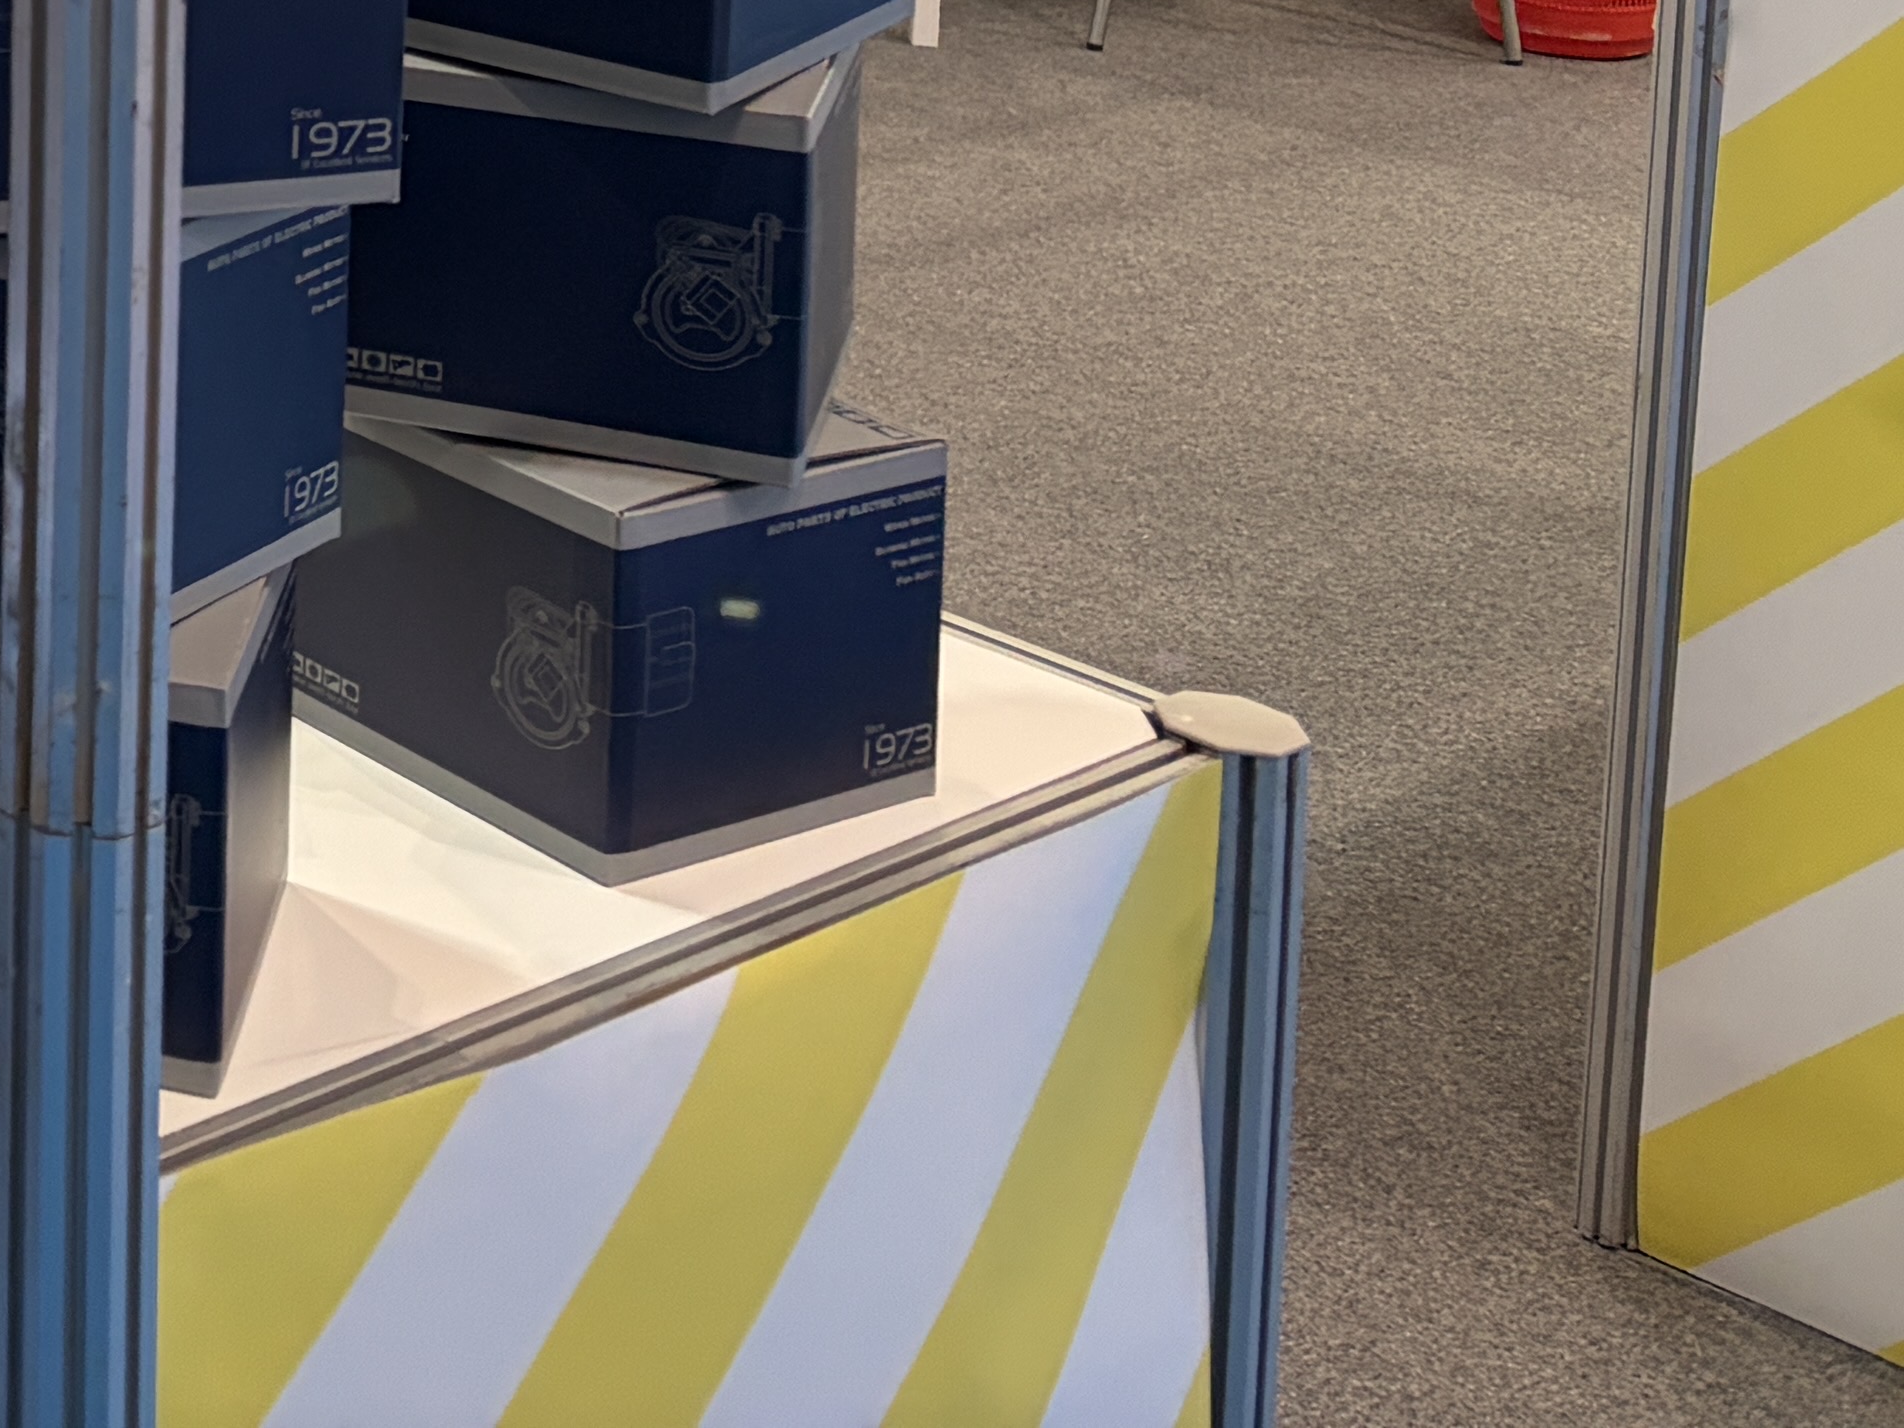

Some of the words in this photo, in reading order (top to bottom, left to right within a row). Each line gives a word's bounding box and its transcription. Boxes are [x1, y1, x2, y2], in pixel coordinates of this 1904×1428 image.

[291, 117, 393, 160] 1973
[284, 460, 339, 518] 1973
[863, 722, 933, 770] 1973
